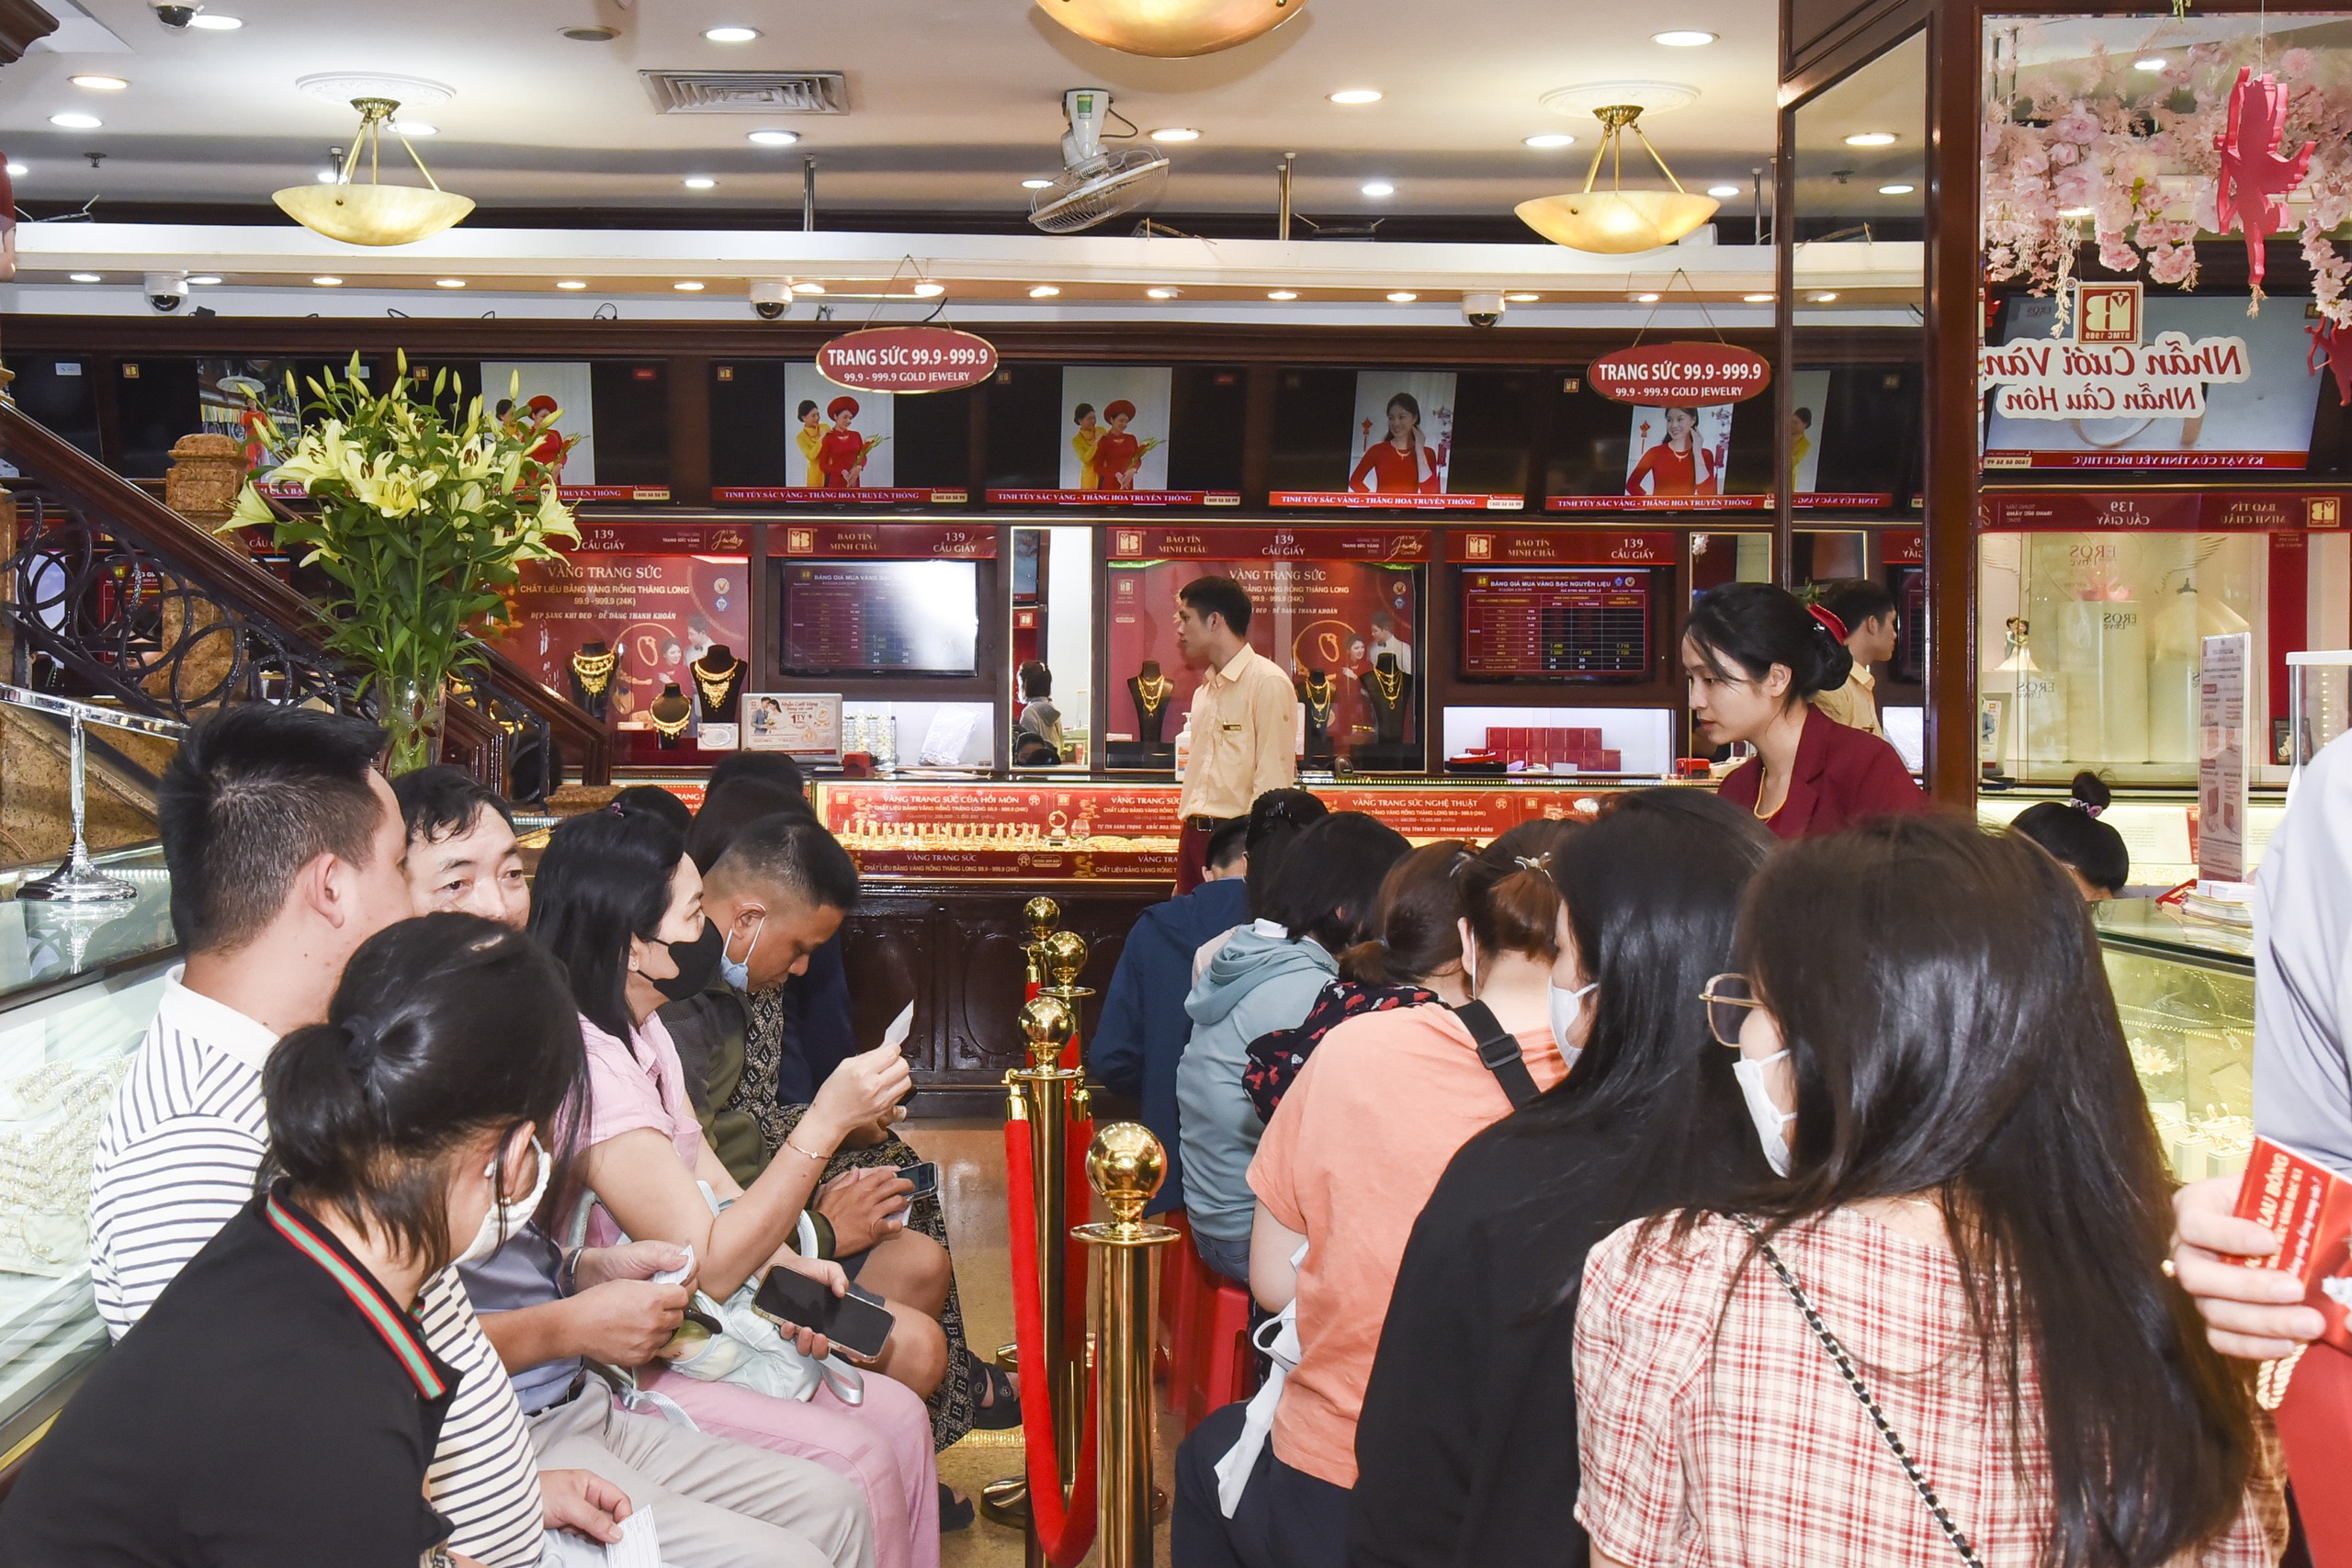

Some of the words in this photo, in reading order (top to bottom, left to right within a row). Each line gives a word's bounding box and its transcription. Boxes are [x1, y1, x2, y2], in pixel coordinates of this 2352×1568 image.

[828, 349, 876, 366] TRANG
[880, 345, 909, 366] SỨC
[1599, 364, 1648, 380] TRANG
[1652, 360, 1680, 380] SỨC
[844, 372, 864, 382] 99.9
[872, 372, 897, 382] 999.9
[899, 372, 926, 381] GOLD
[928, 372, 970, 382] JEWELRY
[1615, 388, 1635, 397] 99.9
[1644, 388, 1668, 397] 999.9
[1671, 387, 1698, 396] GOLD
[1701, 387, 1743, 398] JEWELRY
[594, 529, 615, 539] 139
[945, 532, 966, 542] 139
[603, 540, 626, 550] GIẤY
[1274, 535, 1295, 545] 139
[1623, 538, 1644, 548] 139
[954, 542, 977, 553] GIẤY
[1283, 545, 1306, 556] GIẤY
[1632, 548, 1655, 559] GIẤY
[548, 564, 583, 579] VÀNG
[587, 567, 632, 579] TRANG
[636, 565, 662, 579] SỨC
[1229, 568, 1260, 581] VÀNG
[1263, 570, 1301, 581] TRANG
[1305, 569, 1326, 581] SỨC
[520, 584, 541, 593] CHẤT
[588, 583, 610, 593] VÀNG
[667, 586, 690, 594] LONG
[574, 597, 589, 606] 99.9
[594, 597, 615, 606] 999.9
[616, 597, 637, 607] (24K)
[883, 793, 908, 803] VÀNG
[943, 793, 959, 804] SỨC
[961, 794, 979, 804] CỦA
[999, 794, 1020, 804] MÔN
[1111, 795, 1136, 805] VÀNG
[1351, 797, 1376, 807] VÀNG
[1408, 797, 1423, 807] SỨC
[1425, 798, 1449, 808] NGHỆ
[1451, 799, 1477, 808] THUẬT
[906, 853, 930, 862] VÀNG
[961, 852, 978, 862] SỨC
[1137, 854, 1161, 863] VÀNG
